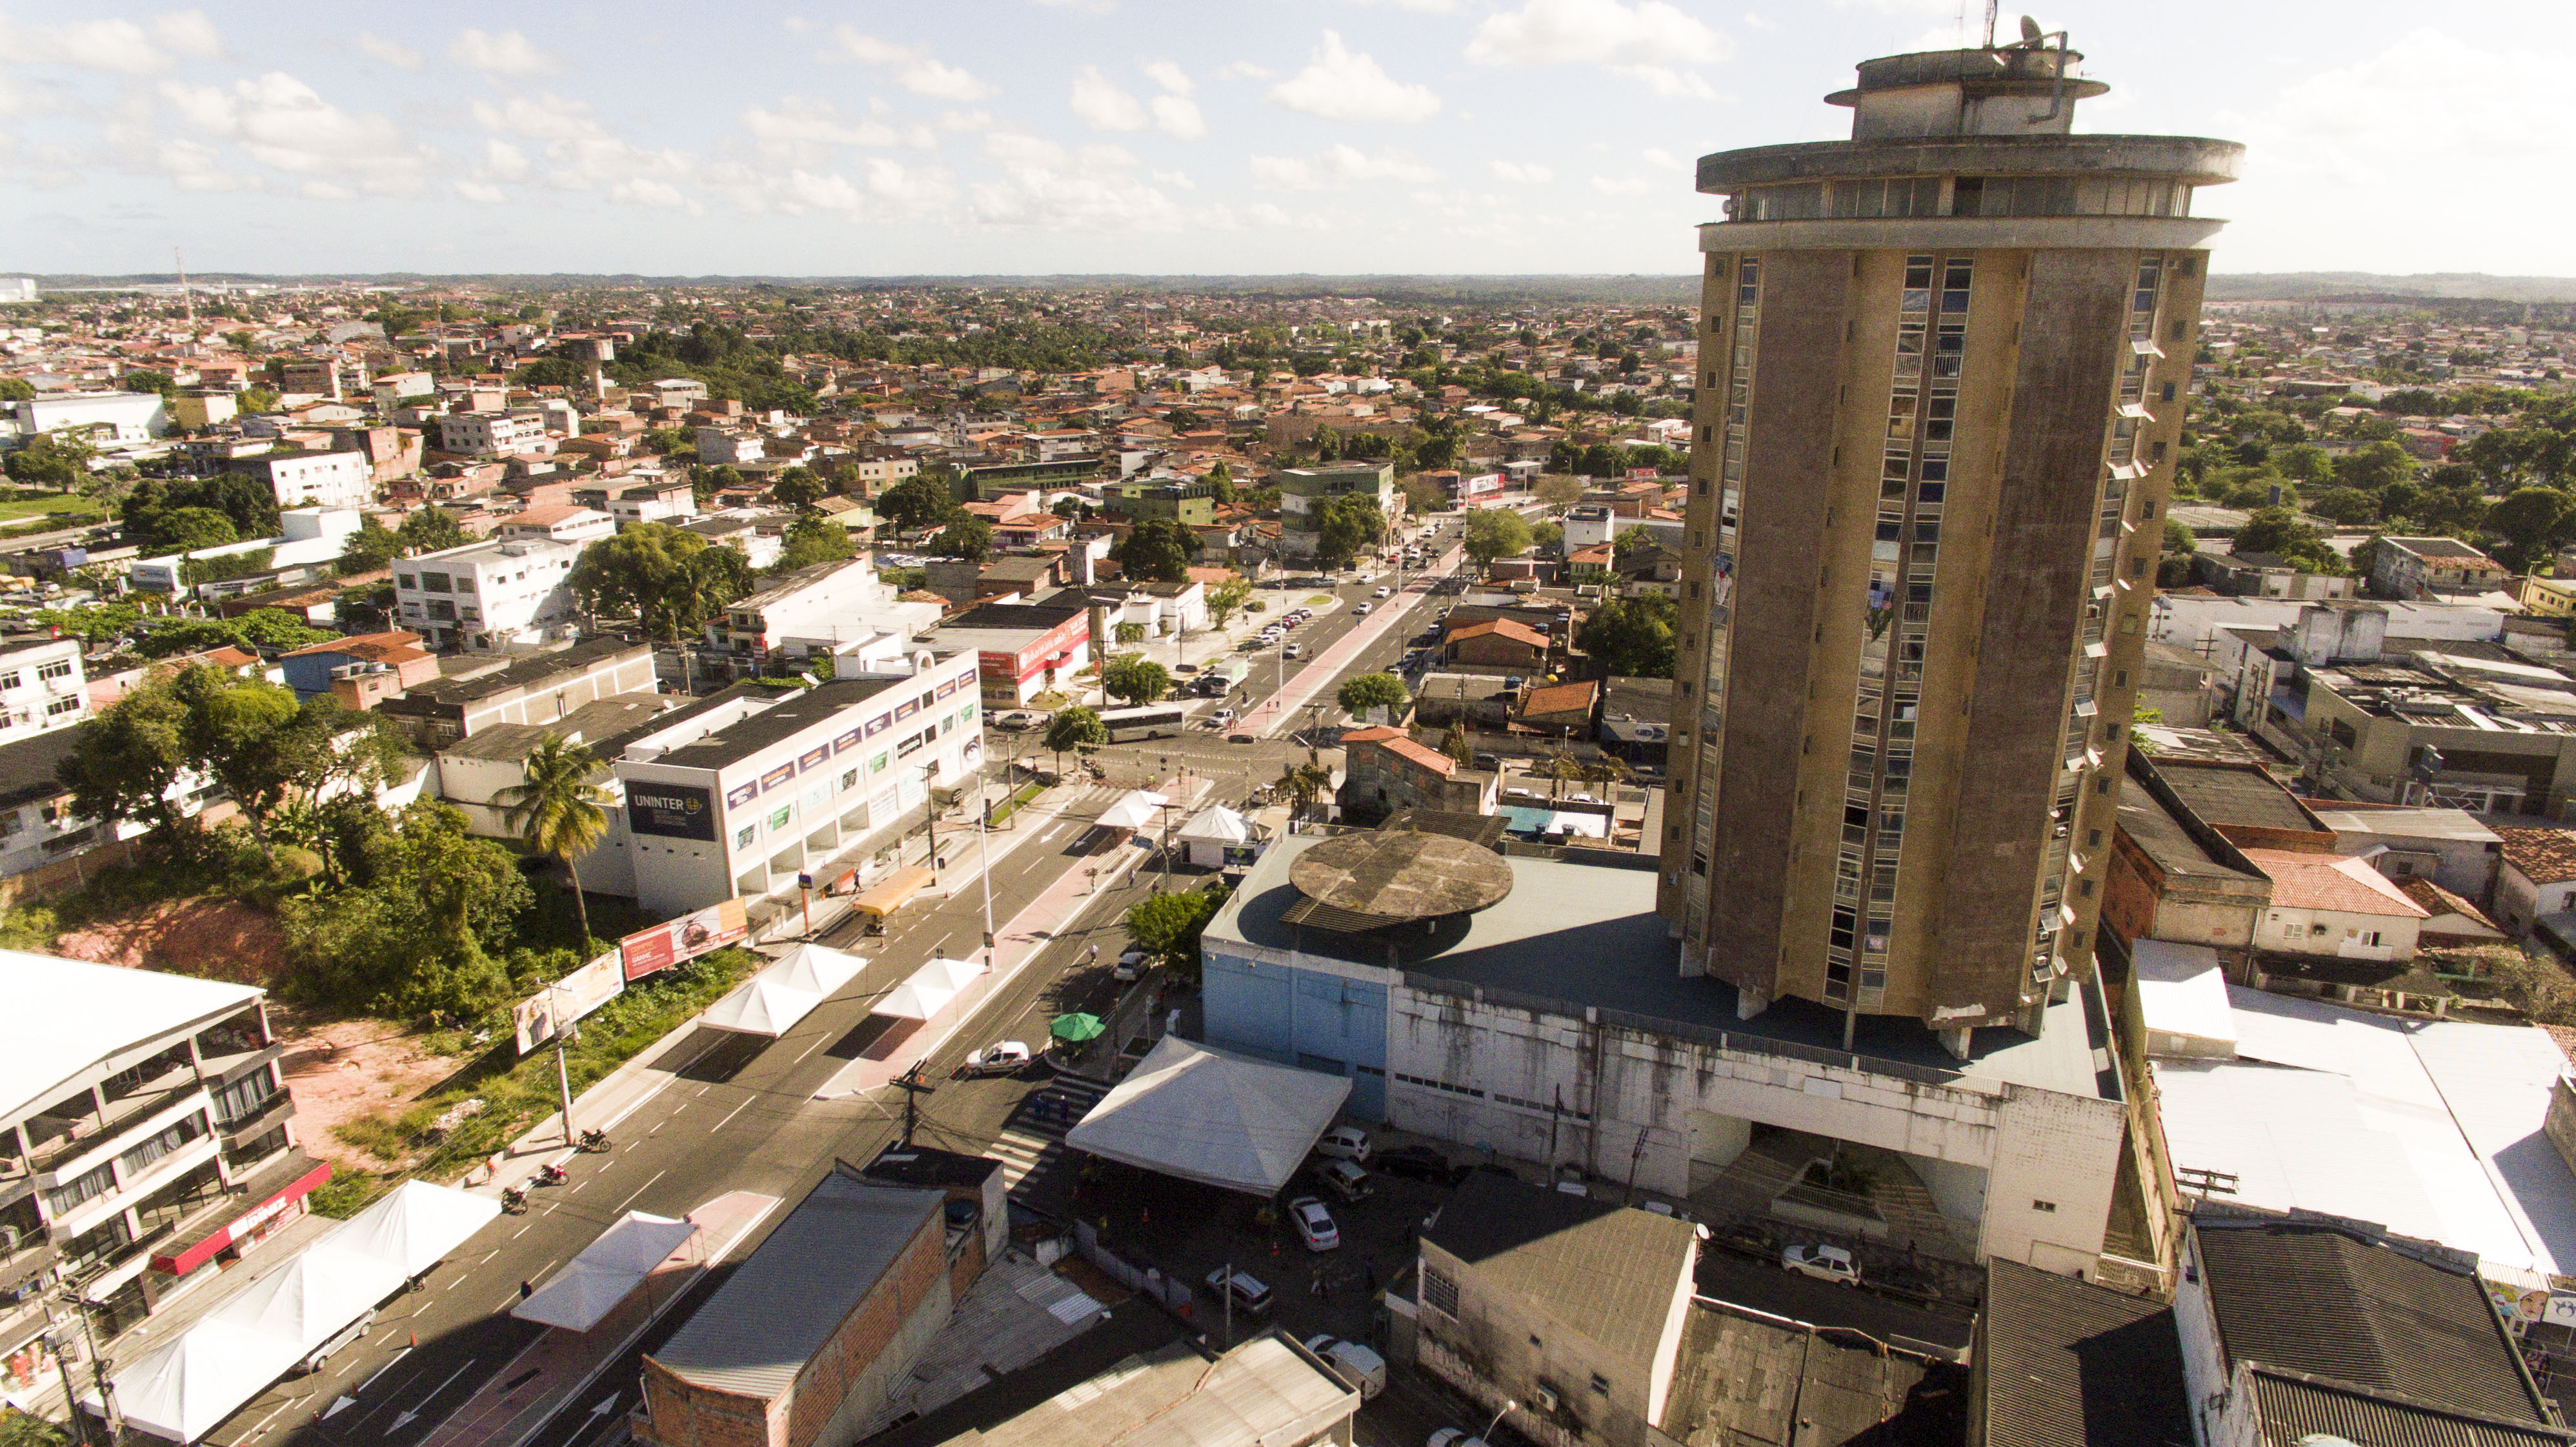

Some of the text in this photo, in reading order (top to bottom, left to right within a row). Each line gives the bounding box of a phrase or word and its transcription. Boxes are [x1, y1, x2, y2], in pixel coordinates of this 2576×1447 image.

[634, 795, 684, 811] UNINTER
[632, 951, 652, 964] GANHE
[247, 1196, 287, 1229] DINIZ
